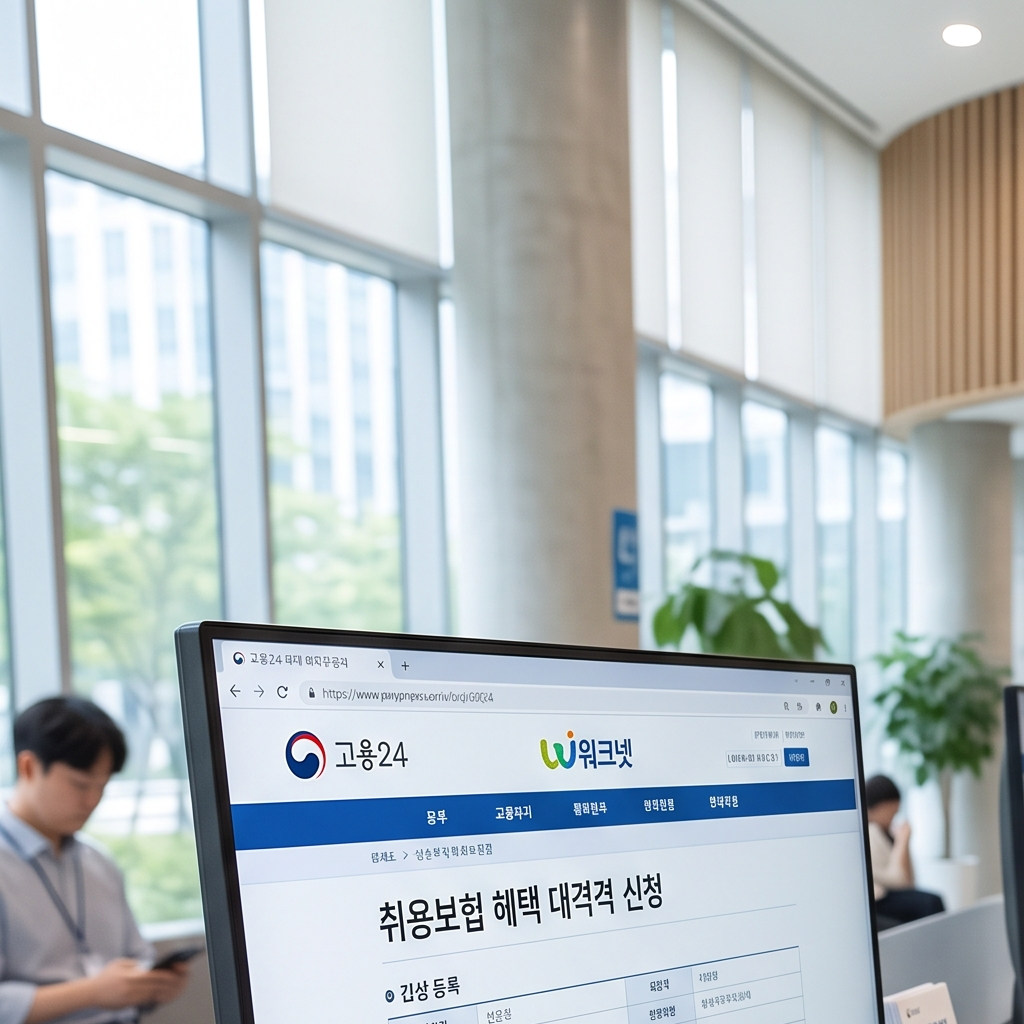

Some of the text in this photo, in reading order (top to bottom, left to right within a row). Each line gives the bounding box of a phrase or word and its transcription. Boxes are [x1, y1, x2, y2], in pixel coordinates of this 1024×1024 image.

[334, 738, 409, 771] 고용24
[578, 738, 633, 769] 워크넷
[622, 872, 663, 912] 신청
[432, 976, 460, 999] 등록
